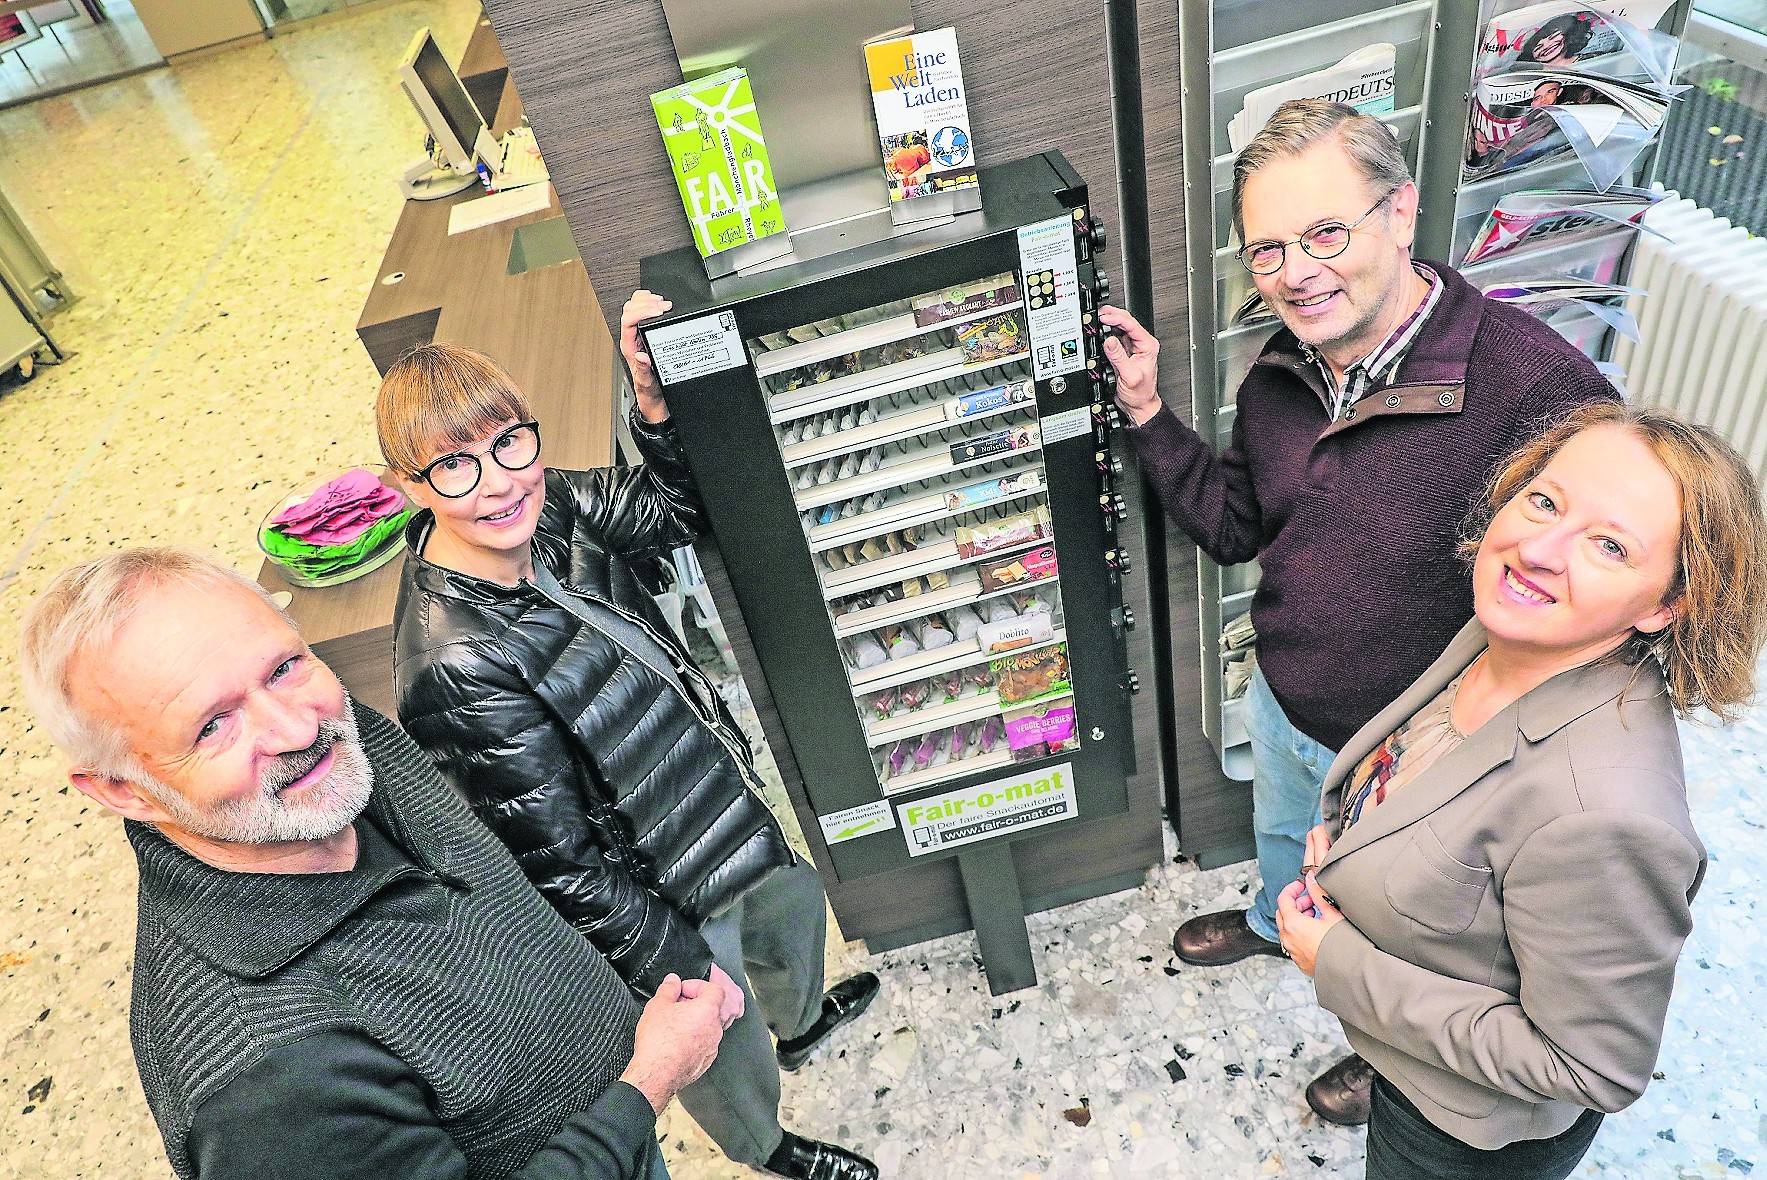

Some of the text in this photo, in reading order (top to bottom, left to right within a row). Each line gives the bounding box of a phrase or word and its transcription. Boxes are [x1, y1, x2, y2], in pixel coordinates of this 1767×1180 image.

[903, 51, 947, 71] Eine
[889, 69, 933, 91] Welt
[903, 86, 960, 108] Laden
[1528, 215, 1600, 237] ster
[975, 398, 1003, 409] Kokos
[1015, 720, 1042, 734] VEGGIE
[1041, 713, 1071, 730] BERRIES
[855, 803, 880, 815] Snack
[905, 771, 1065, 827] Fair-o-mat
[937, 792, 1066, 831] Der faire Snackautomat
[825, 819, 842, 829] hier
[944, 805, 1065, 841] www.fair-o-mat.de
